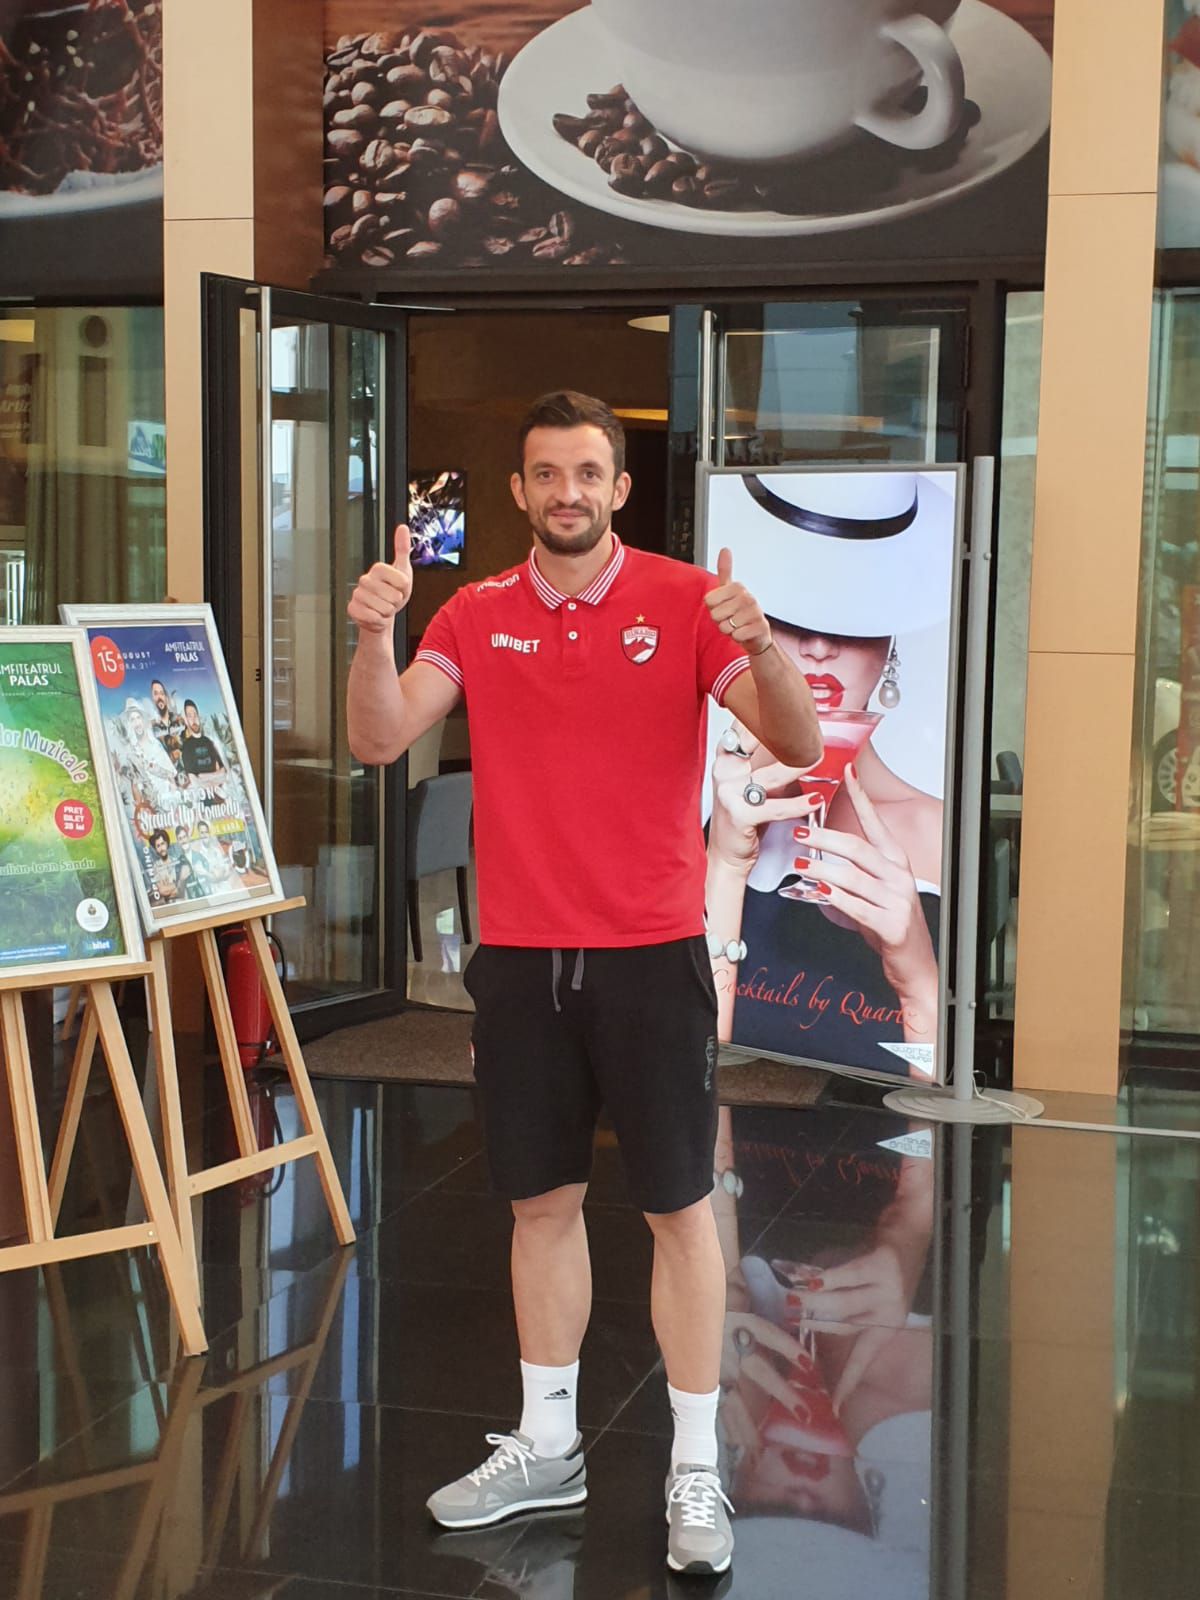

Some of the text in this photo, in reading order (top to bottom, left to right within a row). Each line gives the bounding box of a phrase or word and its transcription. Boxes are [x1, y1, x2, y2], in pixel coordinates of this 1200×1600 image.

[491, 632, 541, 653] UNIBET
[97, 651, 117, 672] 15
[175, 652, 199, 663] PALAS
[9, 675, 49, 686] PALAS
[23, 728, 88, 784] Muzicale
[61, 857, 95, 871] Sandu
[713, 966, 928, 1034] Cocktails by Quartz
